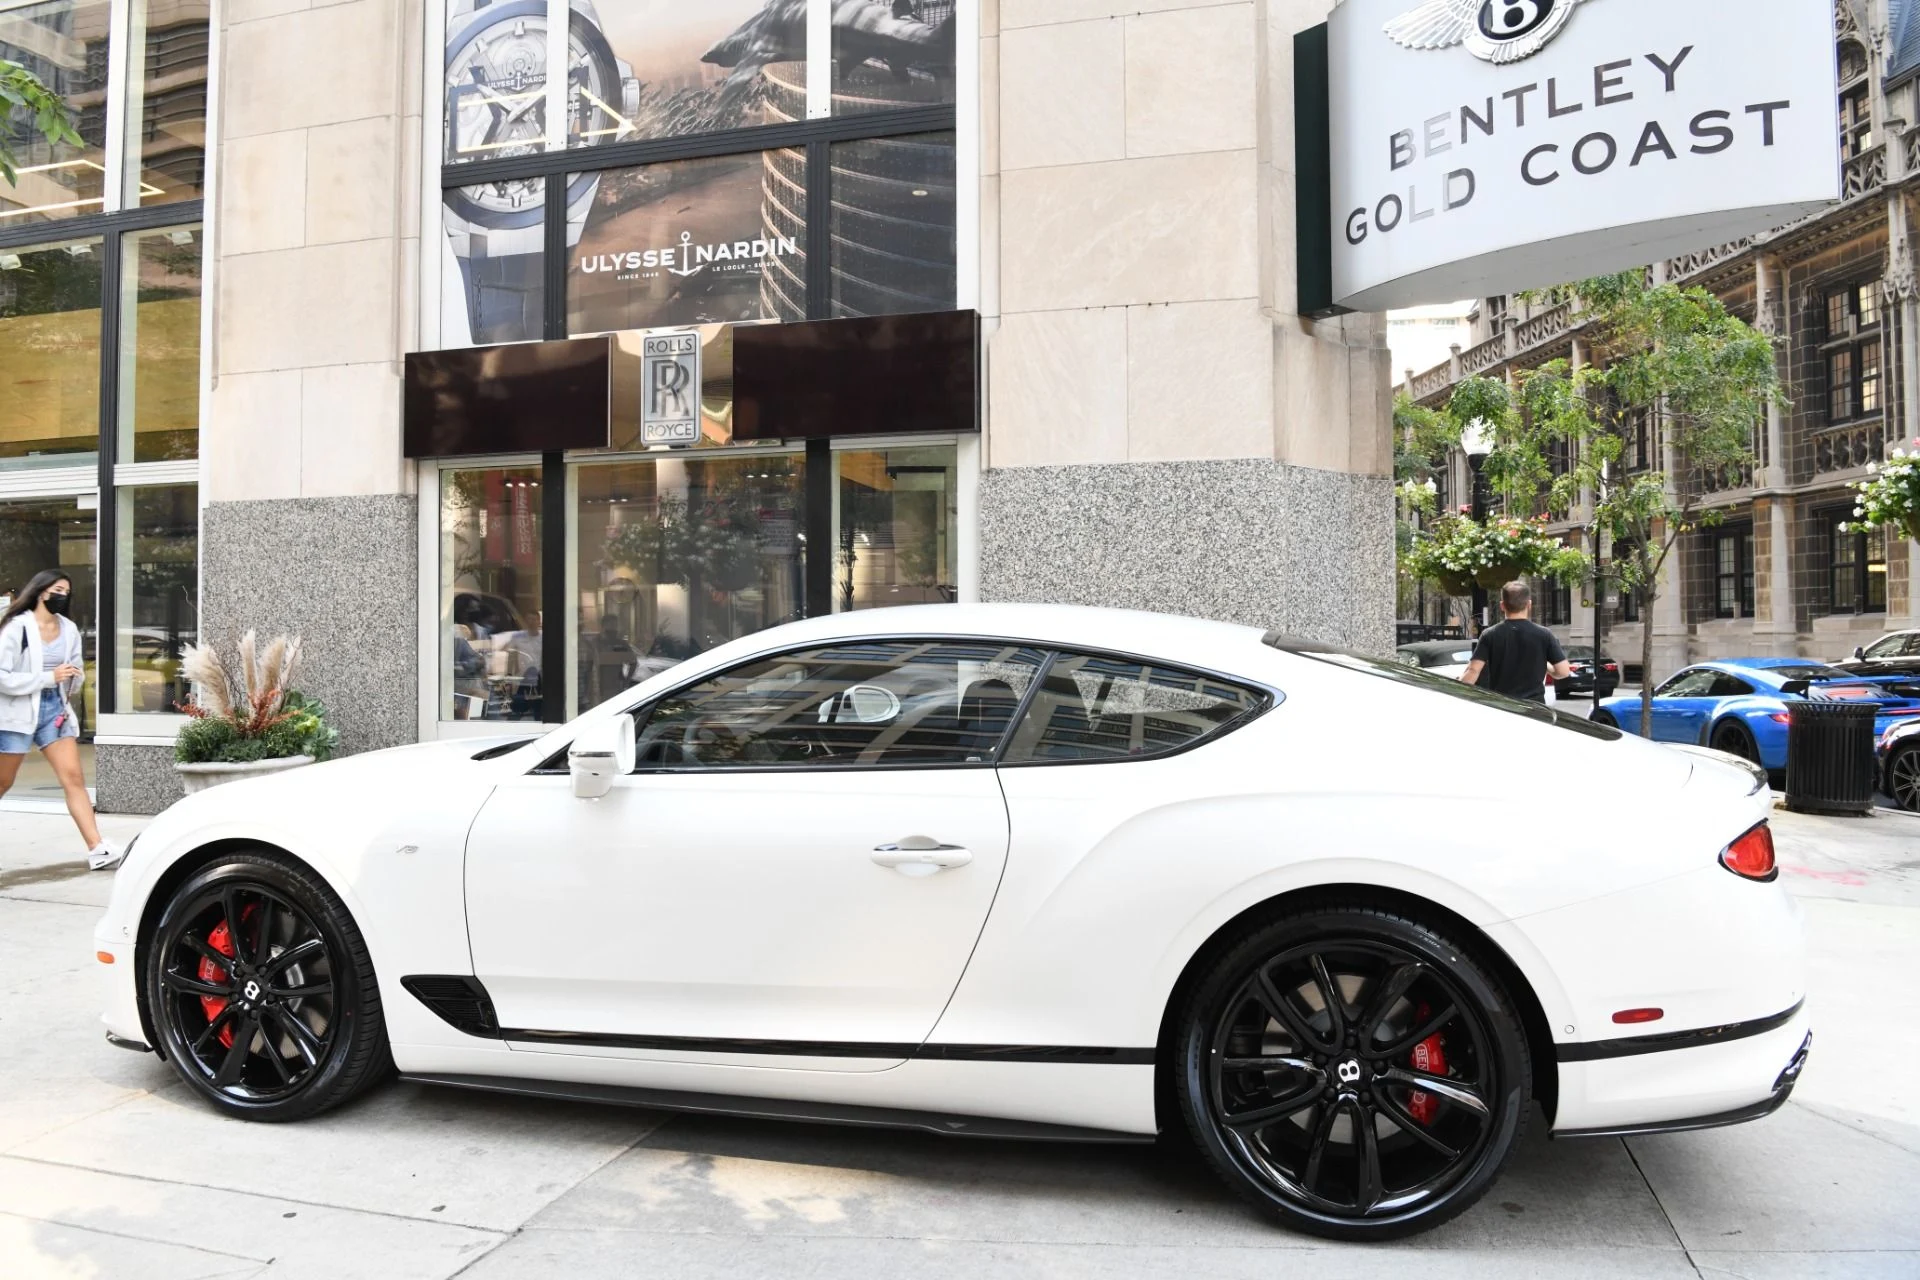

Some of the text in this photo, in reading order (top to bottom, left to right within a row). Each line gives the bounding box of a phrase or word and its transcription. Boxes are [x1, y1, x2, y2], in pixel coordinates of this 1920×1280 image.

[488, 75, 546, 88] ULYSSE NARDI
[1389, 45, 1695, 172] BENTLEY
[1345, 100, 1791, 245] GOLD COAST
[581, 237, 796, 273] ULYSSE NARDIN
[647, 338, 692, 353] ROLLS
[647, 423, 692, 438] ROYCE
[1338, 1060, 1360, 1082] B
